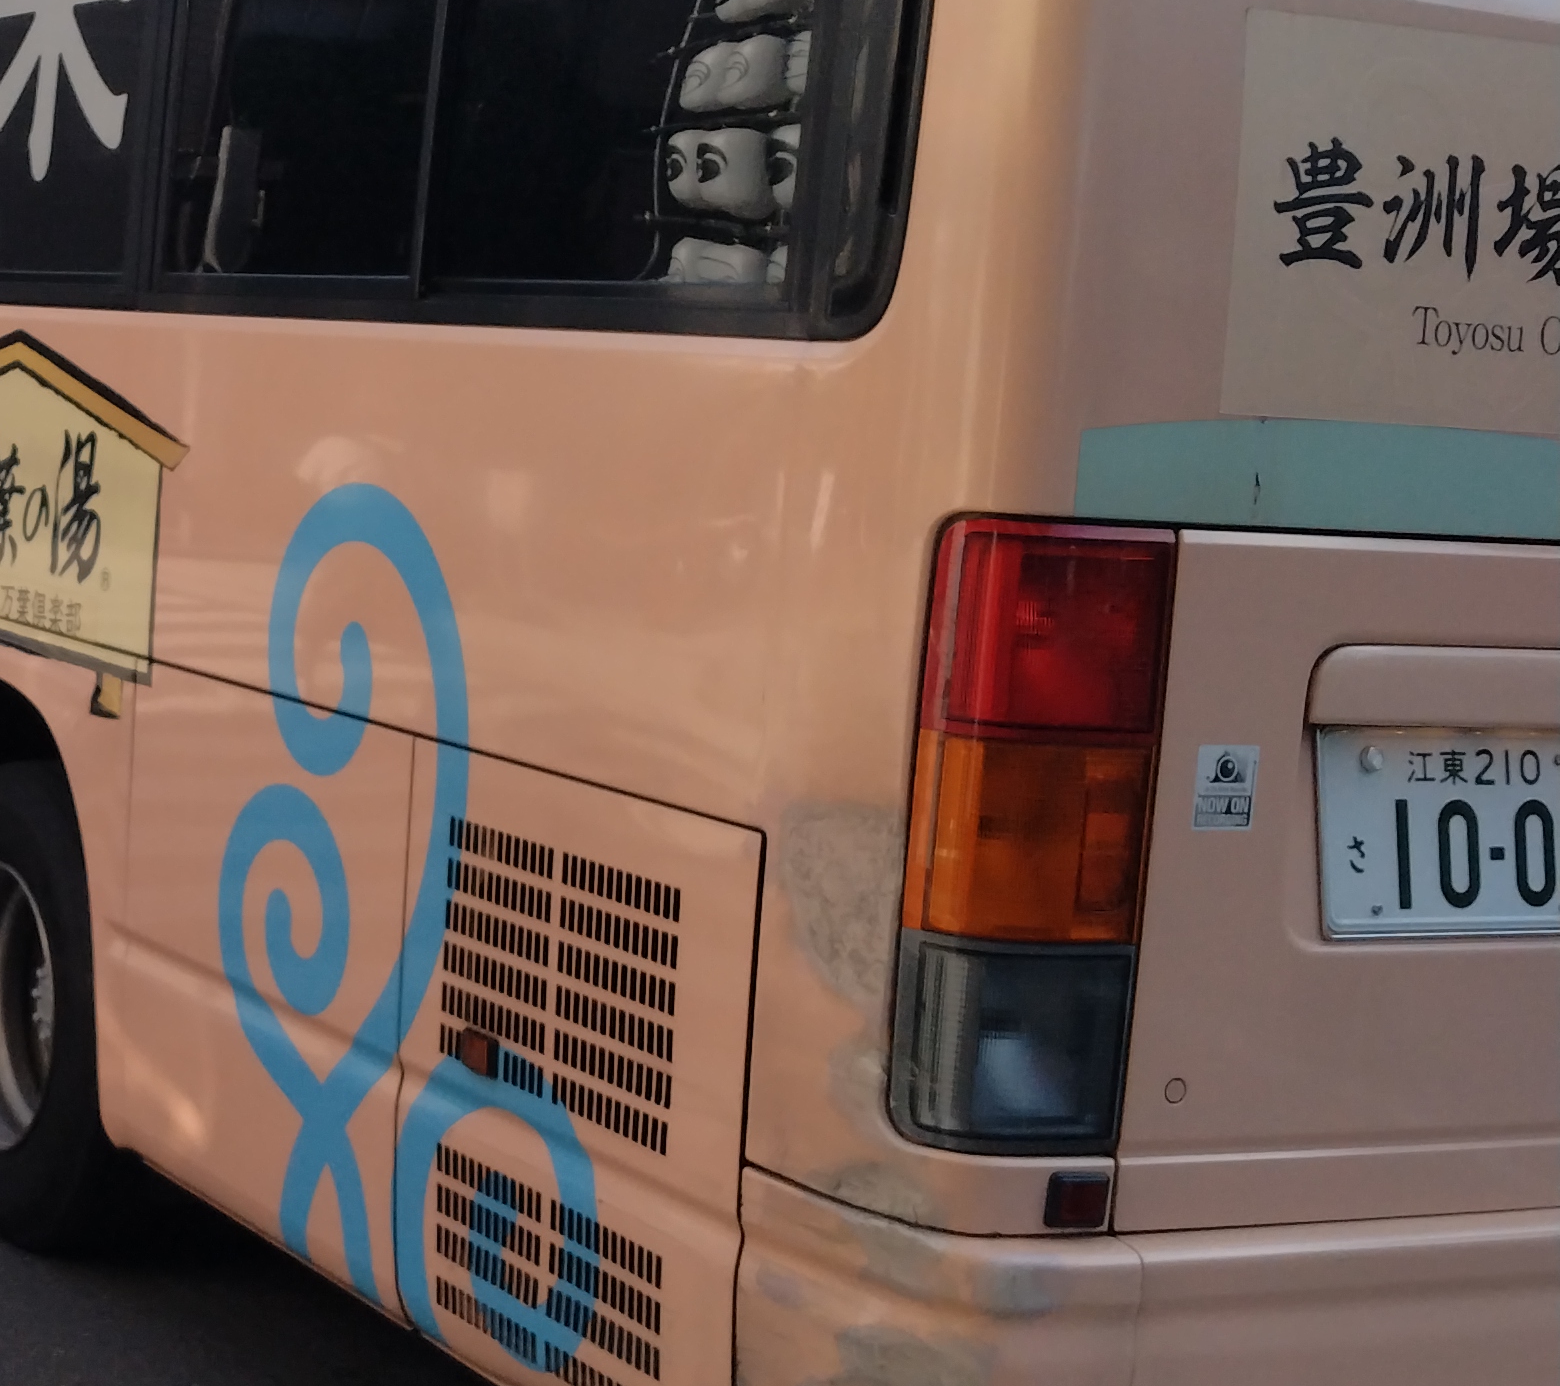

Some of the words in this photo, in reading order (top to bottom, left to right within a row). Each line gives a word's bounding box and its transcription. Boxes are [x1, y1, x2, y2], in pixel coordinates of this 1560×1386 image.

[1414, 305, 1524, 355] Toyosu
[1407, 749, 1541, 785] 江東210
[1198, 797, 1230, 813] NOW
[1230, 797, 1249, 813] ON
[1348, 836, 1366, 873] さ
